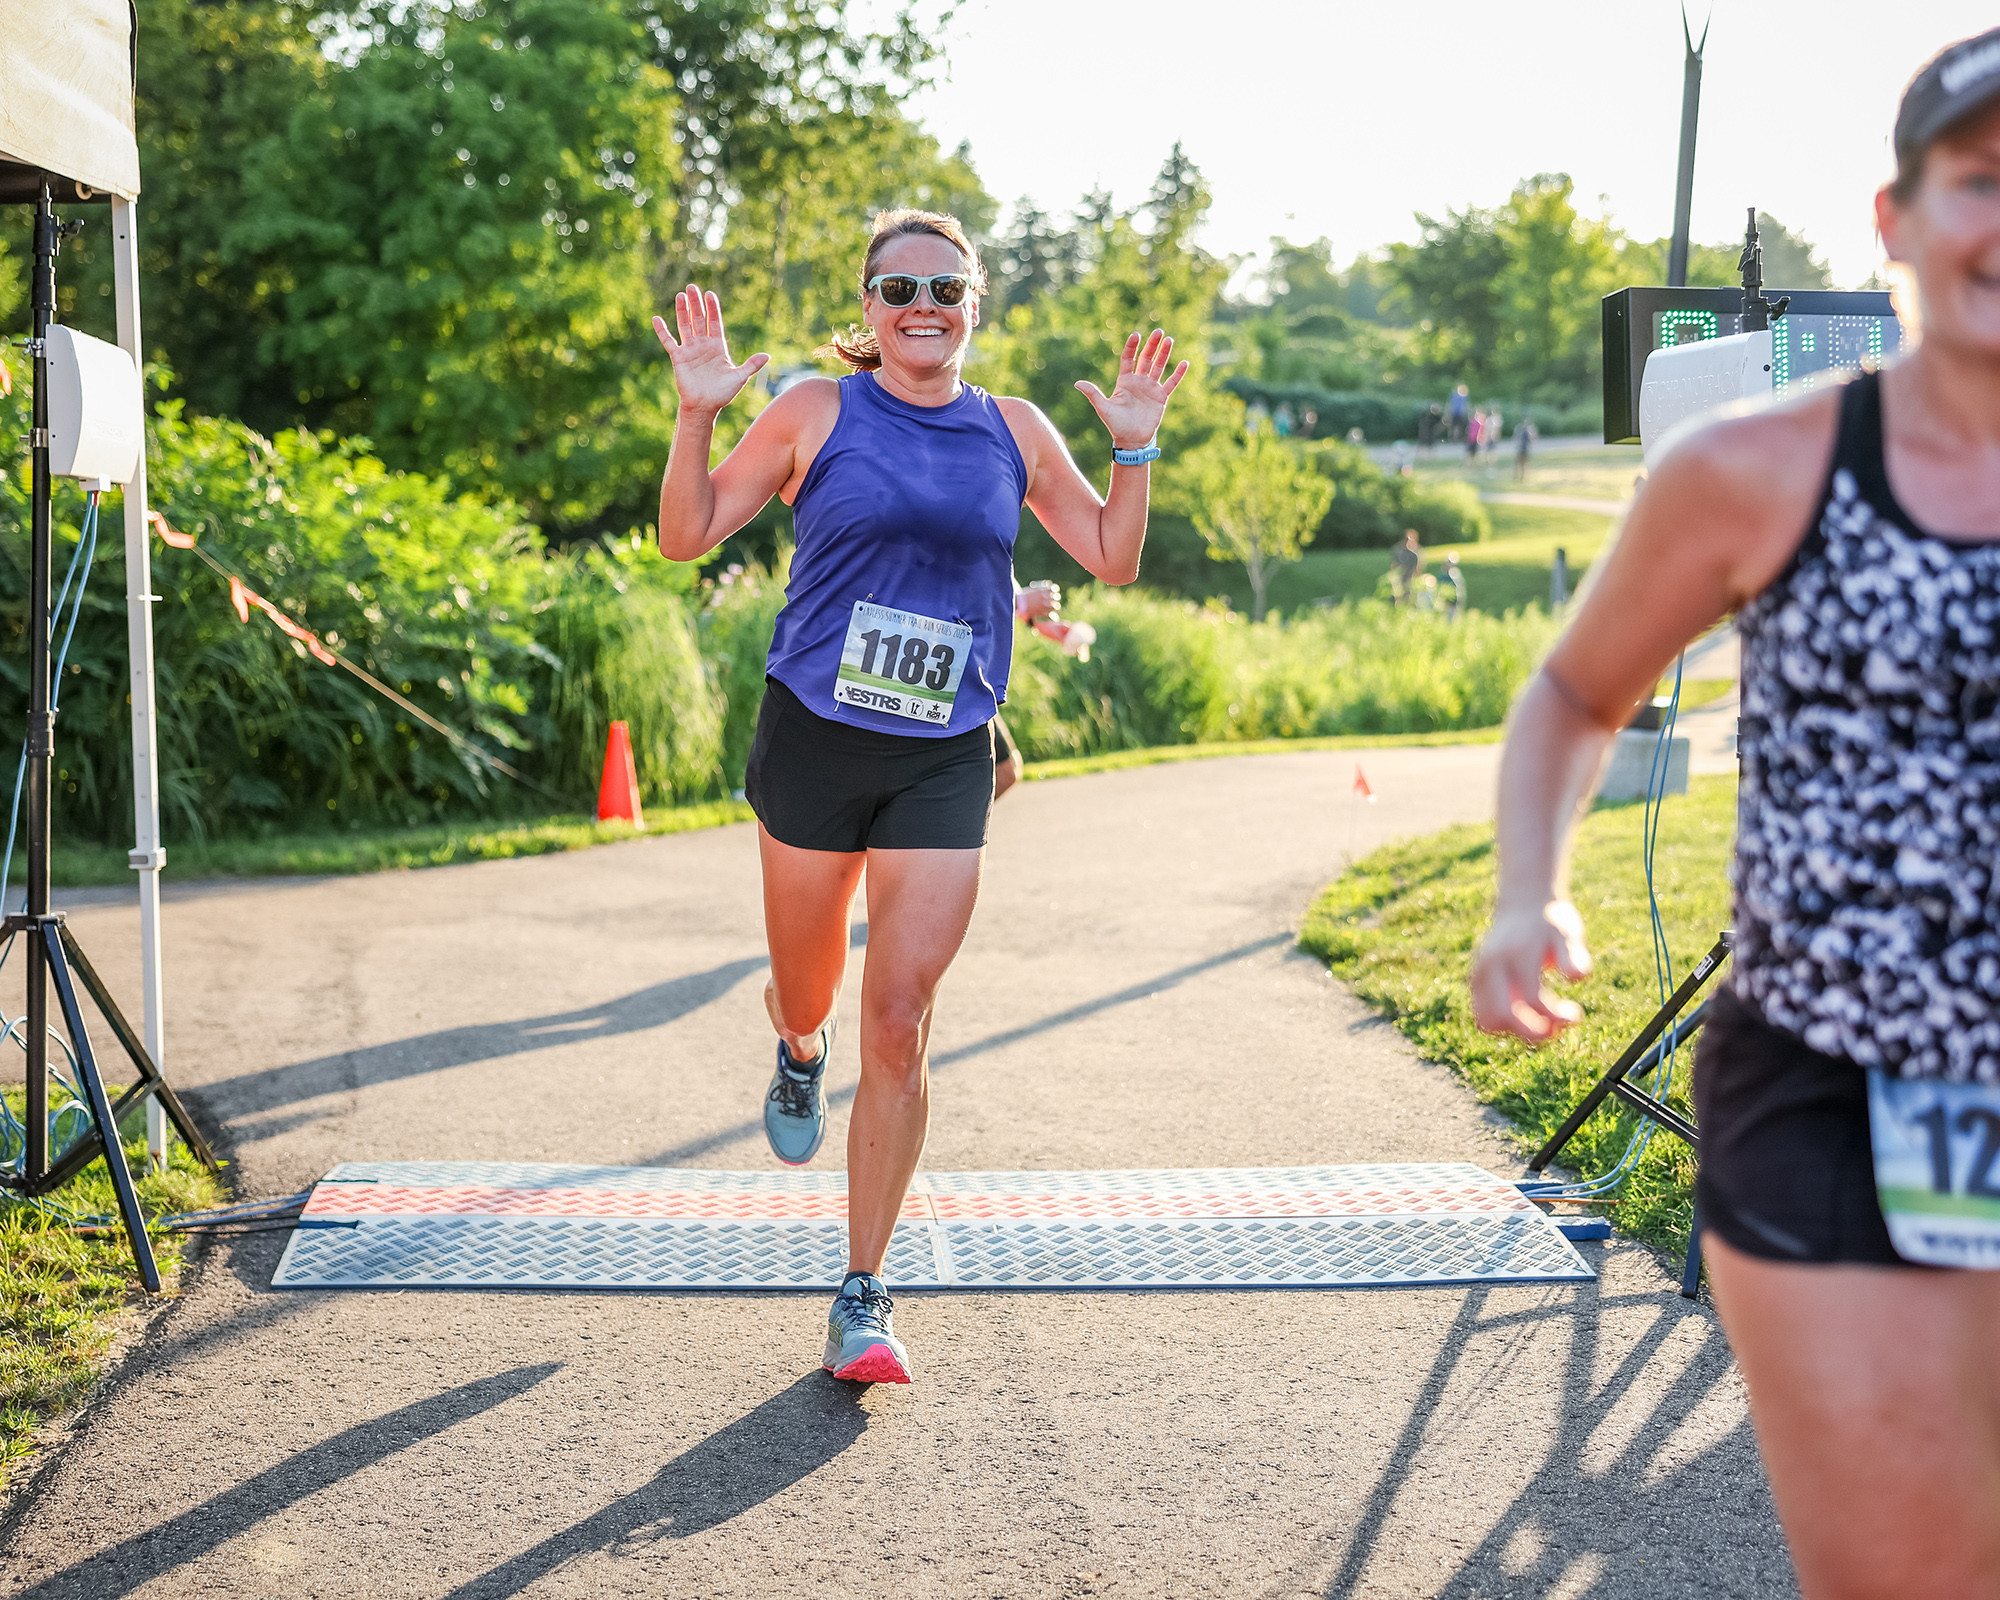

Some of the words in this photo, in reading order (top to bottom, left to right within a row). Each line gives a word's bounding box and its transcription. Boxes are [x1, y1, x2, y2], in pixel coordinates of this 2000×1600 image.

[863, 605, 884, 620] ENDLESS
[885, 610, 906, 625] SUMMER
[923, 619, 935, 632] RUN
[935, 622, 952, 637] SERIES
[860, 628, 955, 691] 1183
